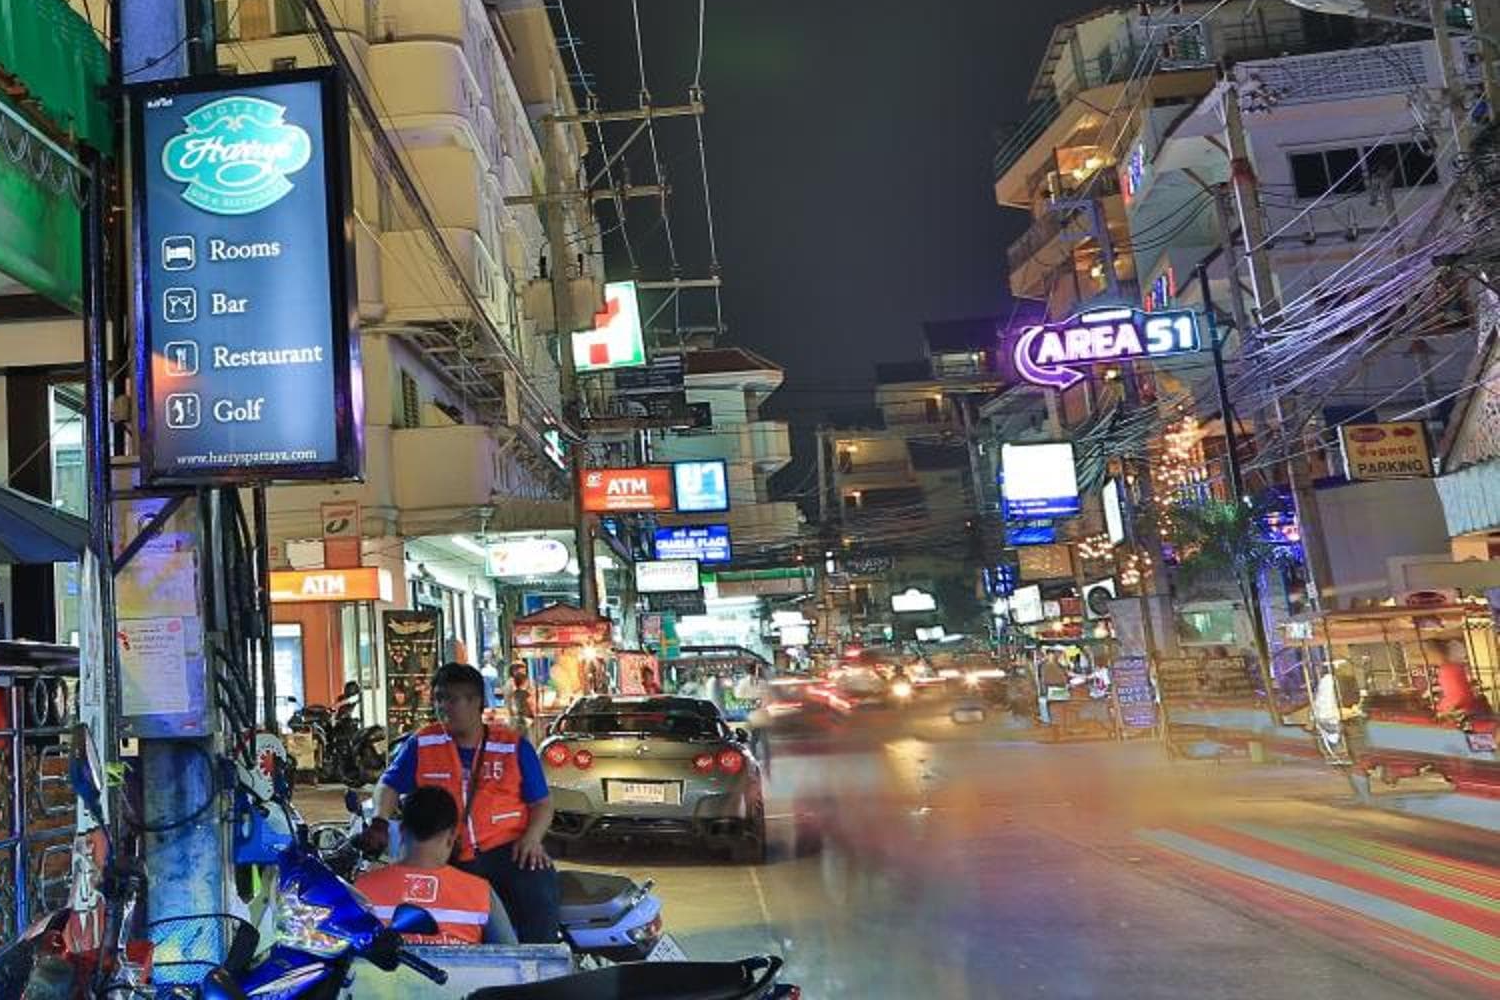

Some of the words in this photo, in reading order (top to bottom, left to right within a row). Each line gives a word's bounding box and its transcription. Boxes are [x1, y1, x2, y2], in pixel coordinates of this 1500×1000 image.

[210, 240, 281, 260] Rooms
[212, 293, 248, 315] Bar
[1035, 323, 1143, 364] AREA
[1145, 316, 1193, 353] 51
[213, 346, 323, 368] Restaurant
[213, 398, 265, 422] Golf
[177, 449, 317, 466] www.harryspattaya.com
[1358, 459, 1424, 473] PARKING
[607, 478, 648, 495] ATM
[302, 575, 346, 595] ATM
[484, 761, 503, 780] 15
